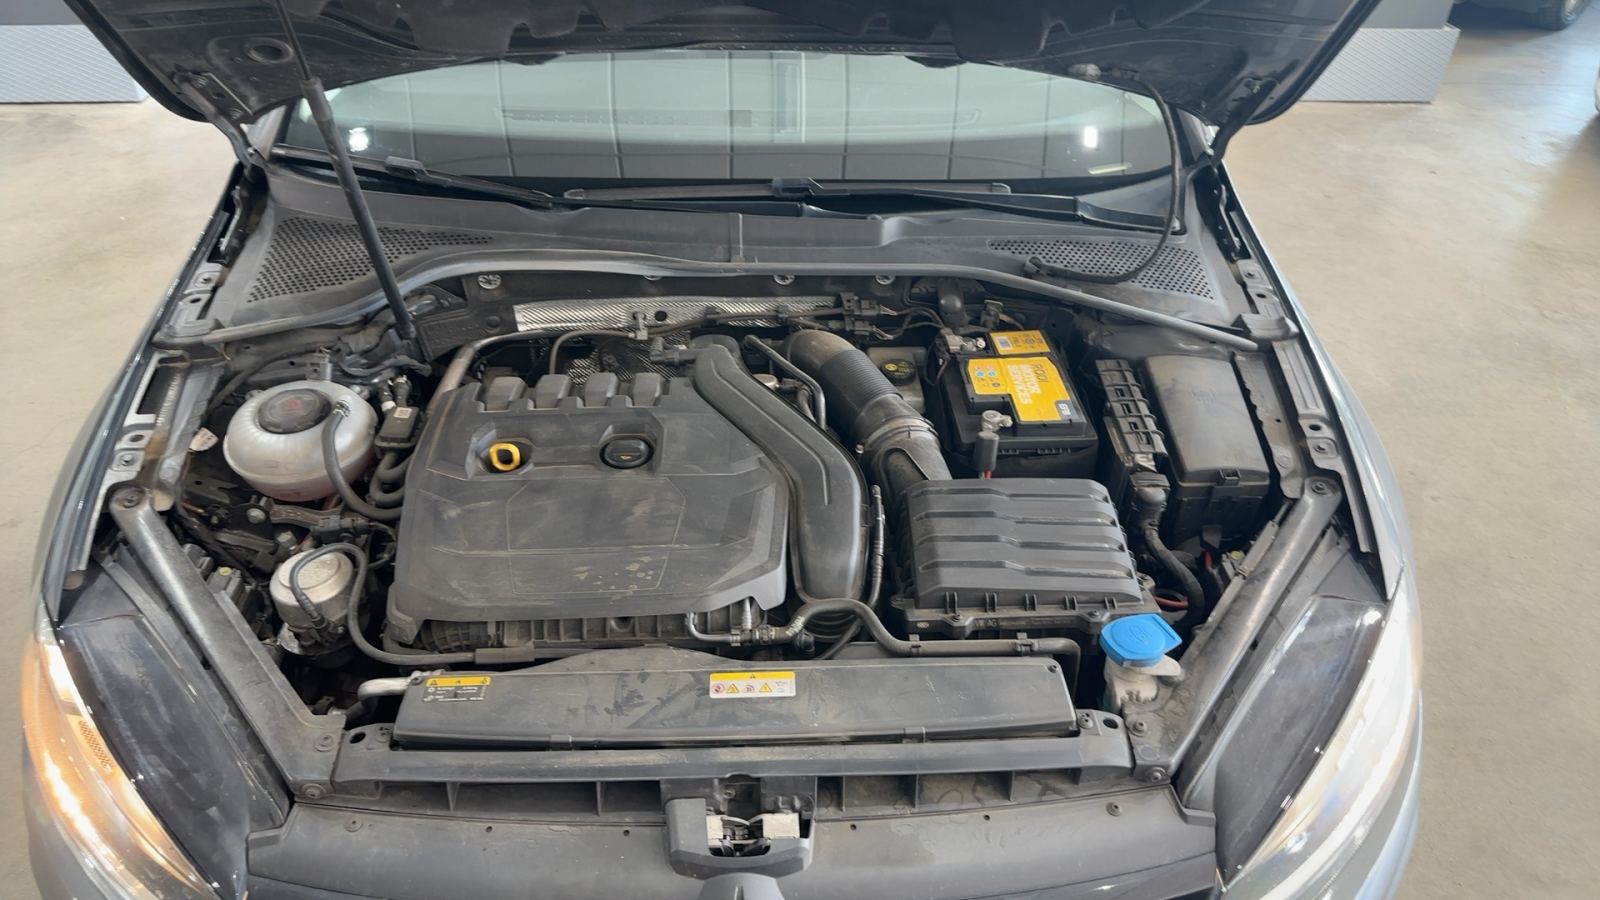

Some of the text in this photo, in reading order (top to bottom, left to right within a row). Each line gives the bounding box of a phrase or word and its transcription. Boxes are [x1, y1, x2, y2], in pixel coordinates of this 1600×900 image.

[1008, 365, 1033, 404] SERVICES
[1021, 364, 1042, 393] MOTOR
[1032, 364, 1049, 382] RODI
